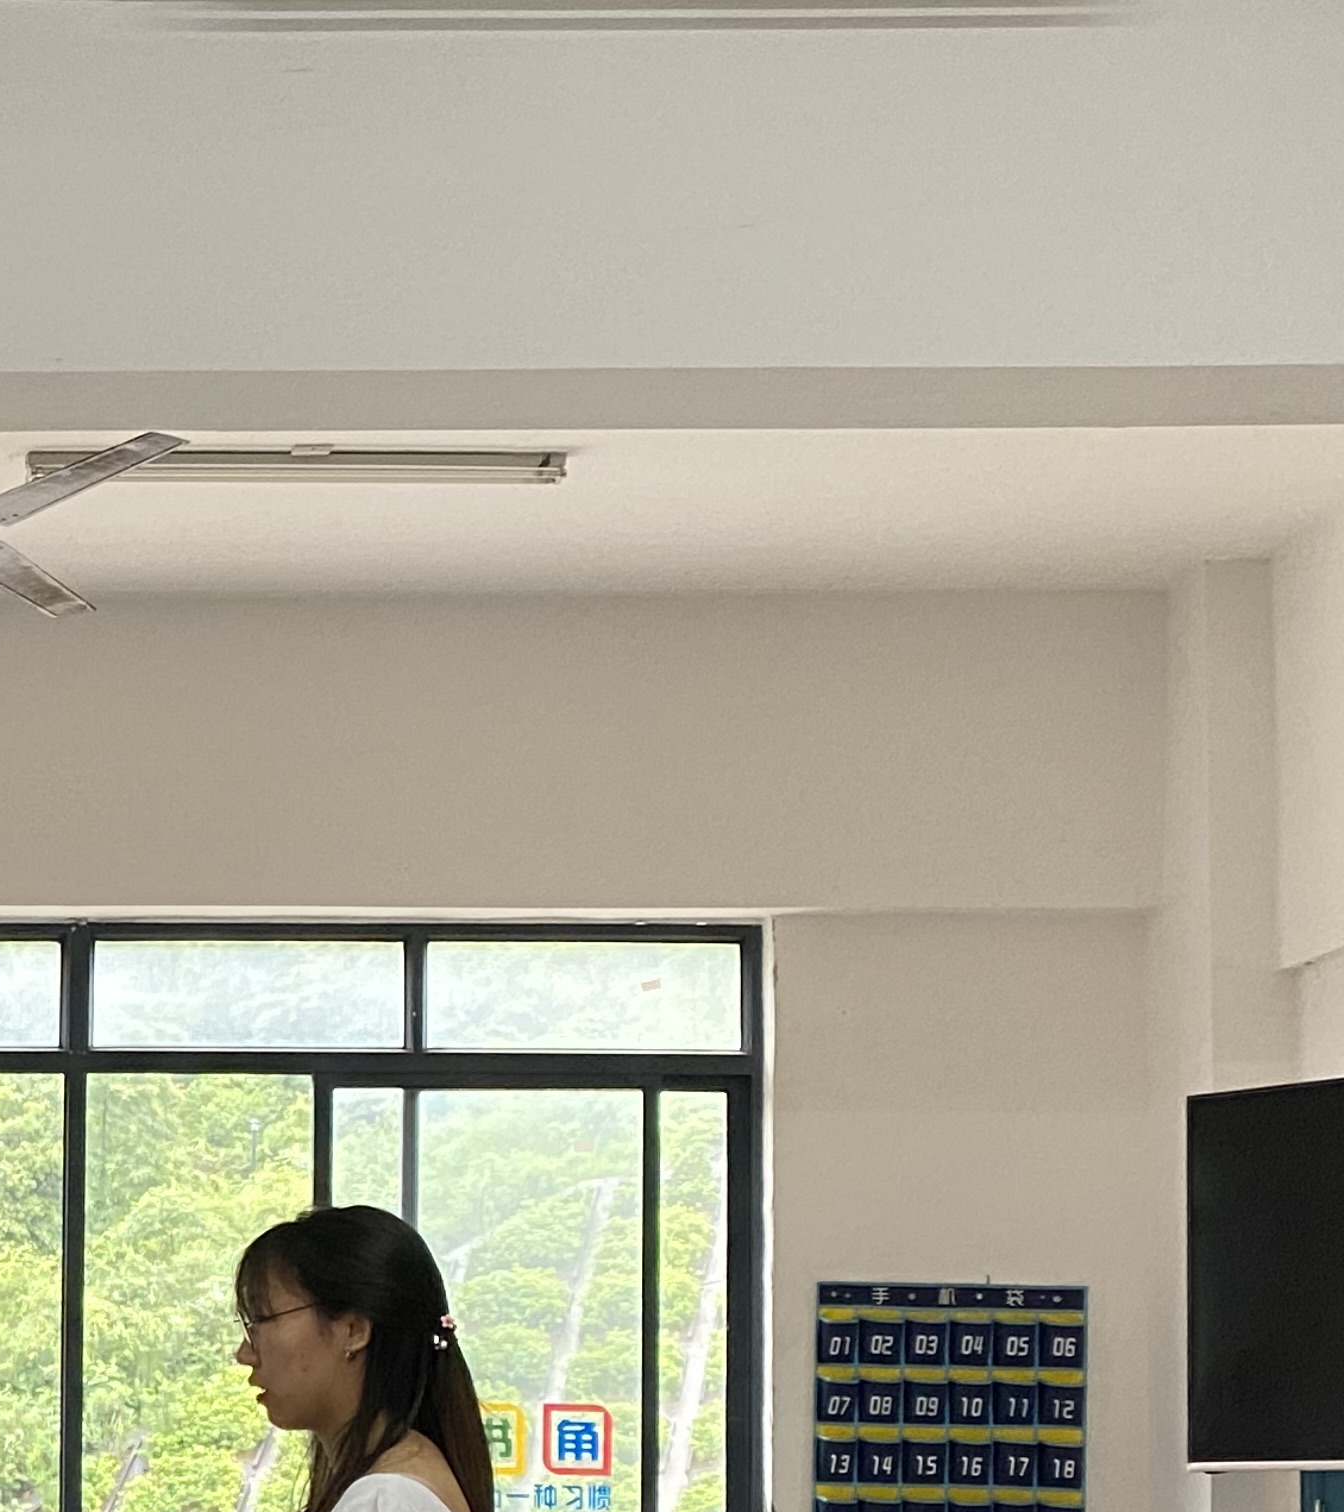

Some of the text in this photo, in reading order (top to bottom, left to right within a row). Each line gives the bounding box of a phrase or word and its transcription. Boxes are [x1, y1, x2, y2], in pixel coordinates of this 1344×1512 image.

[829, 1334, 1077, 1357] 01 02 03 04 05 06
[827, 1395, 1075, 1419] 07 08 09 10 11 12
[830, 1453, 1075, 1479] 13 14 15 16 17 18
[495, 1483, 611, 1511] 一种习惯
